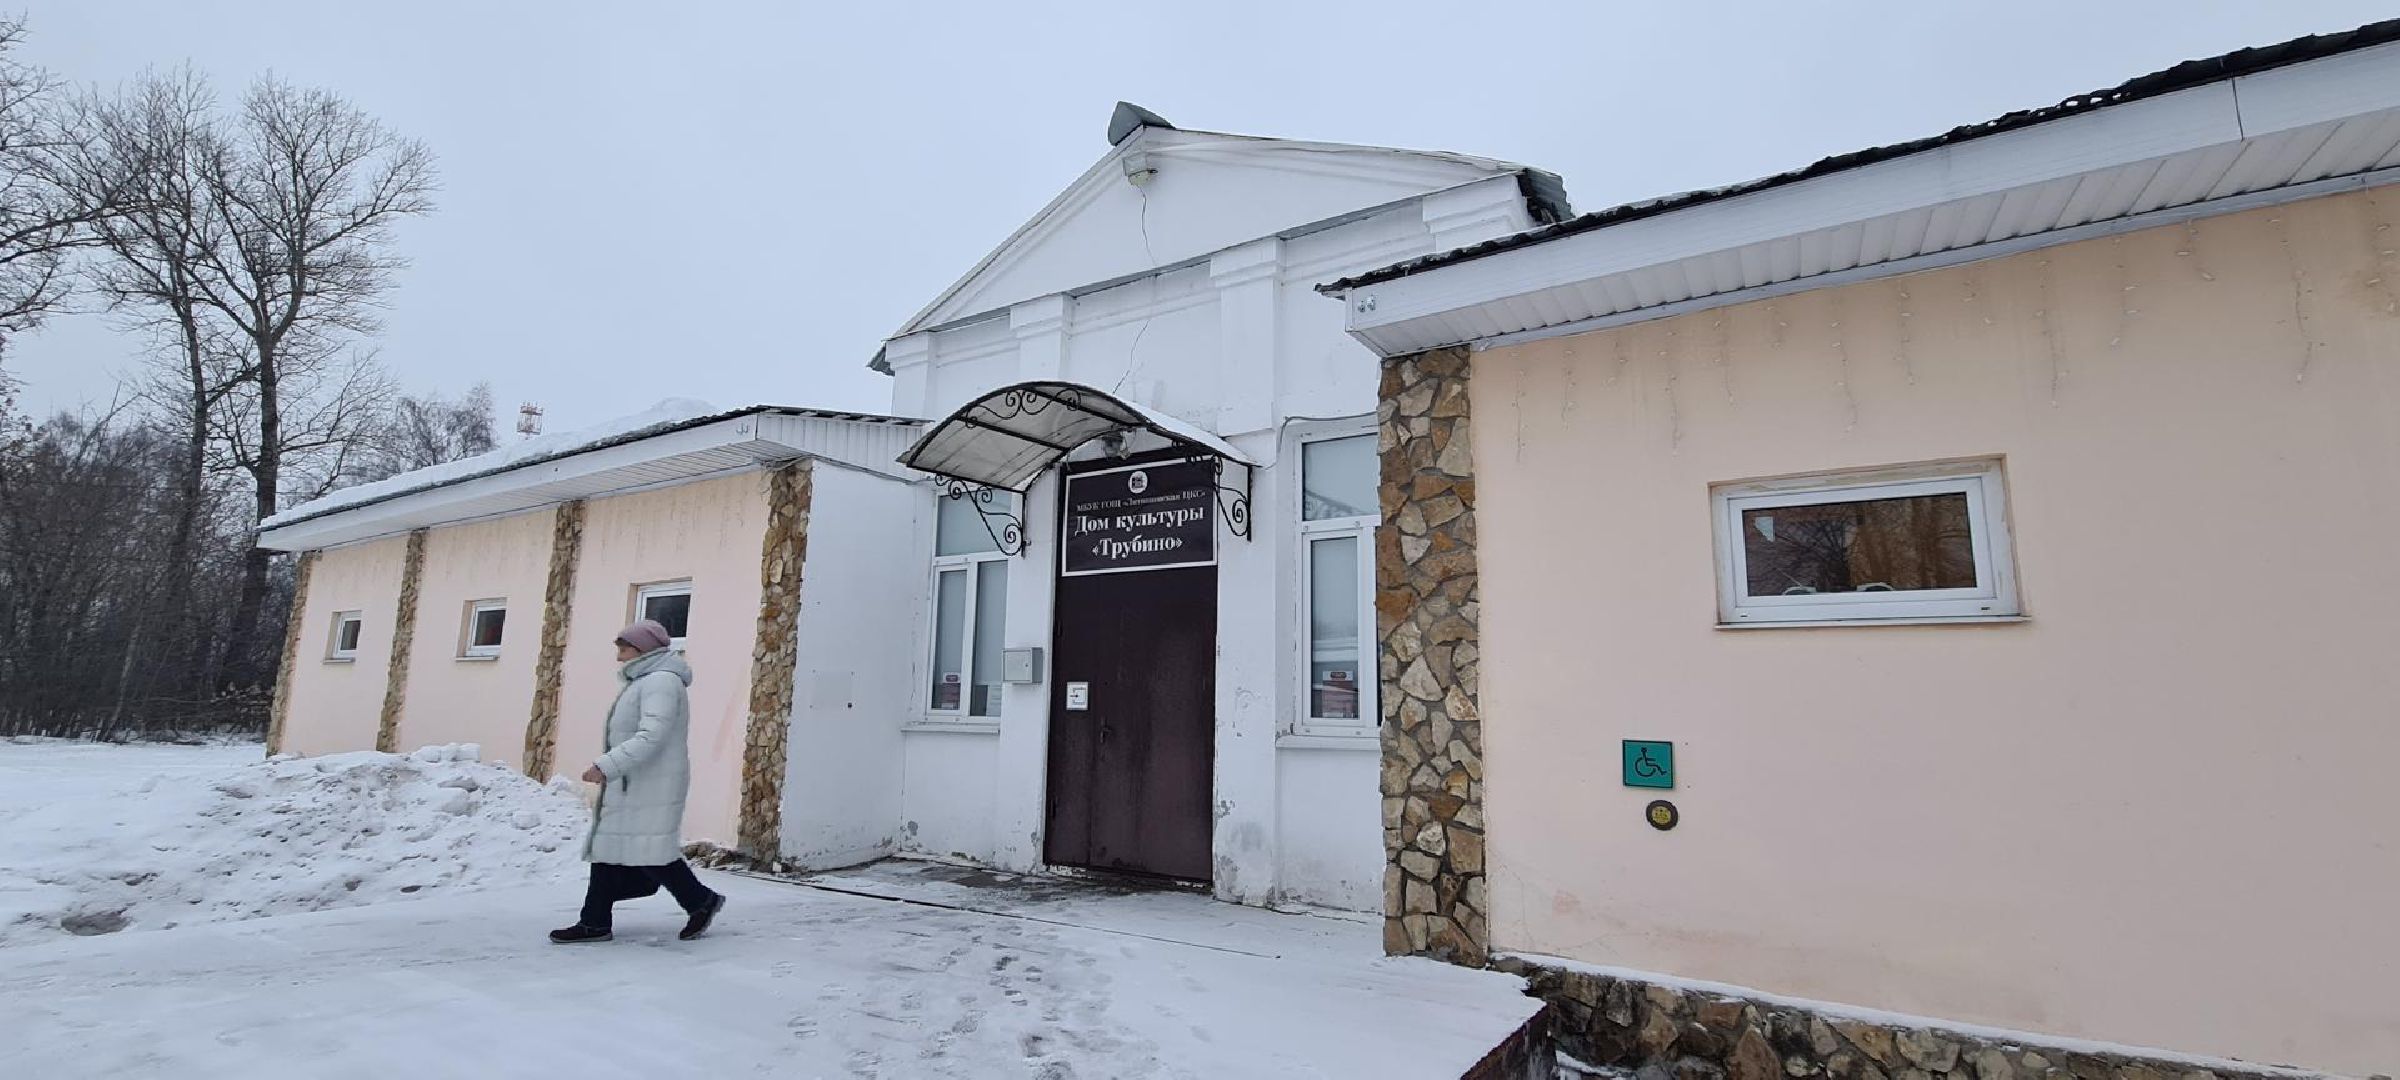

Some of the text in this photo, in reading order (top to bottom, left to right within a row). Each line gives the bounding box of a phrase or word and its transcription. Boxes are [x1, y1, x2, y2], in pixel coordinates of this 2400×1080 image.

[1074, 507, 1204, 536] Дом культуры
[1091, 535, 1183, 560] «Трубино»
